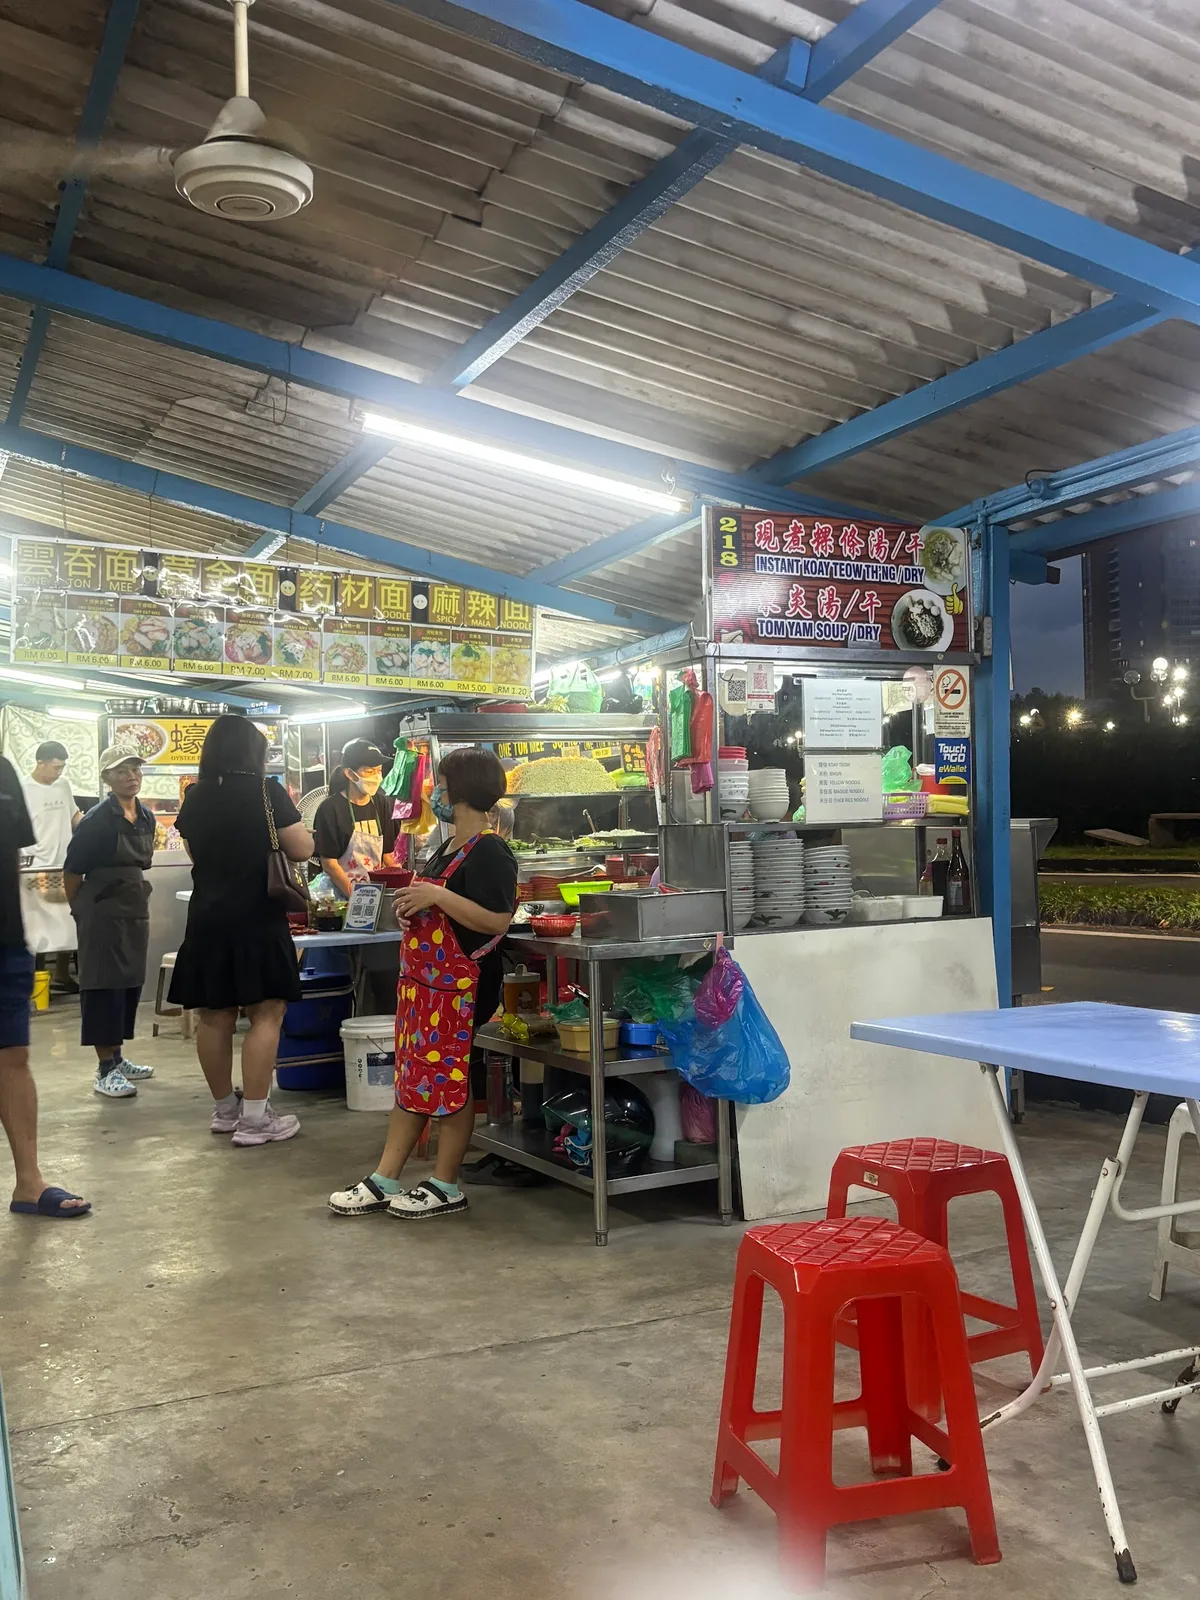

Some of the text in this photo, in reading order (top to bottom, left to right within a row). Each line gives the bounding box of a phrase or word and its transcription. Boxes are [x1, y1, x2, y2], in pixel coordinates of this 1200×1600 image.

[719, 516, 739, 567] 218
[755, 554, 801, 575] INSTANT
[803, 558, 831, 579] KOAY
[832, 560, 864, 581] TEOW
[904, 566, 925, 584] DRY
[68, 578, 92, 589] TON
[109, 581, 133, 593] MEE
[436, 614, 533, 631] SPICY MALA NOODLE
[757, 618, 787, 638] TOM
[787, 620, 814, 640] YAM
[815, 621, 848, 641] SOUP
[856, 623, 881, 641] DRY
[24, 650, 58, 660] RM 6.00
[76, 654, 90, 664] RM
[129, 658, 162, 669] RM 6.00
[183, 662, 214, 672] RM 6.00
[230, 665, 266, 676] RM 7.00
[280, 669, 313, 680] RM 7.00
[331, 674, 360, 683] RM 6.00
[375, 677, 403, 687] RM 6.00
[417, 680, 444, 689] RM 6.00
[457, 682, 487, 692] RM 5.00
[497, 685, 527, 696] RM 1.20
[938, 742, 967, 754] Touch
[938, 764, 968, 773] eWallet
